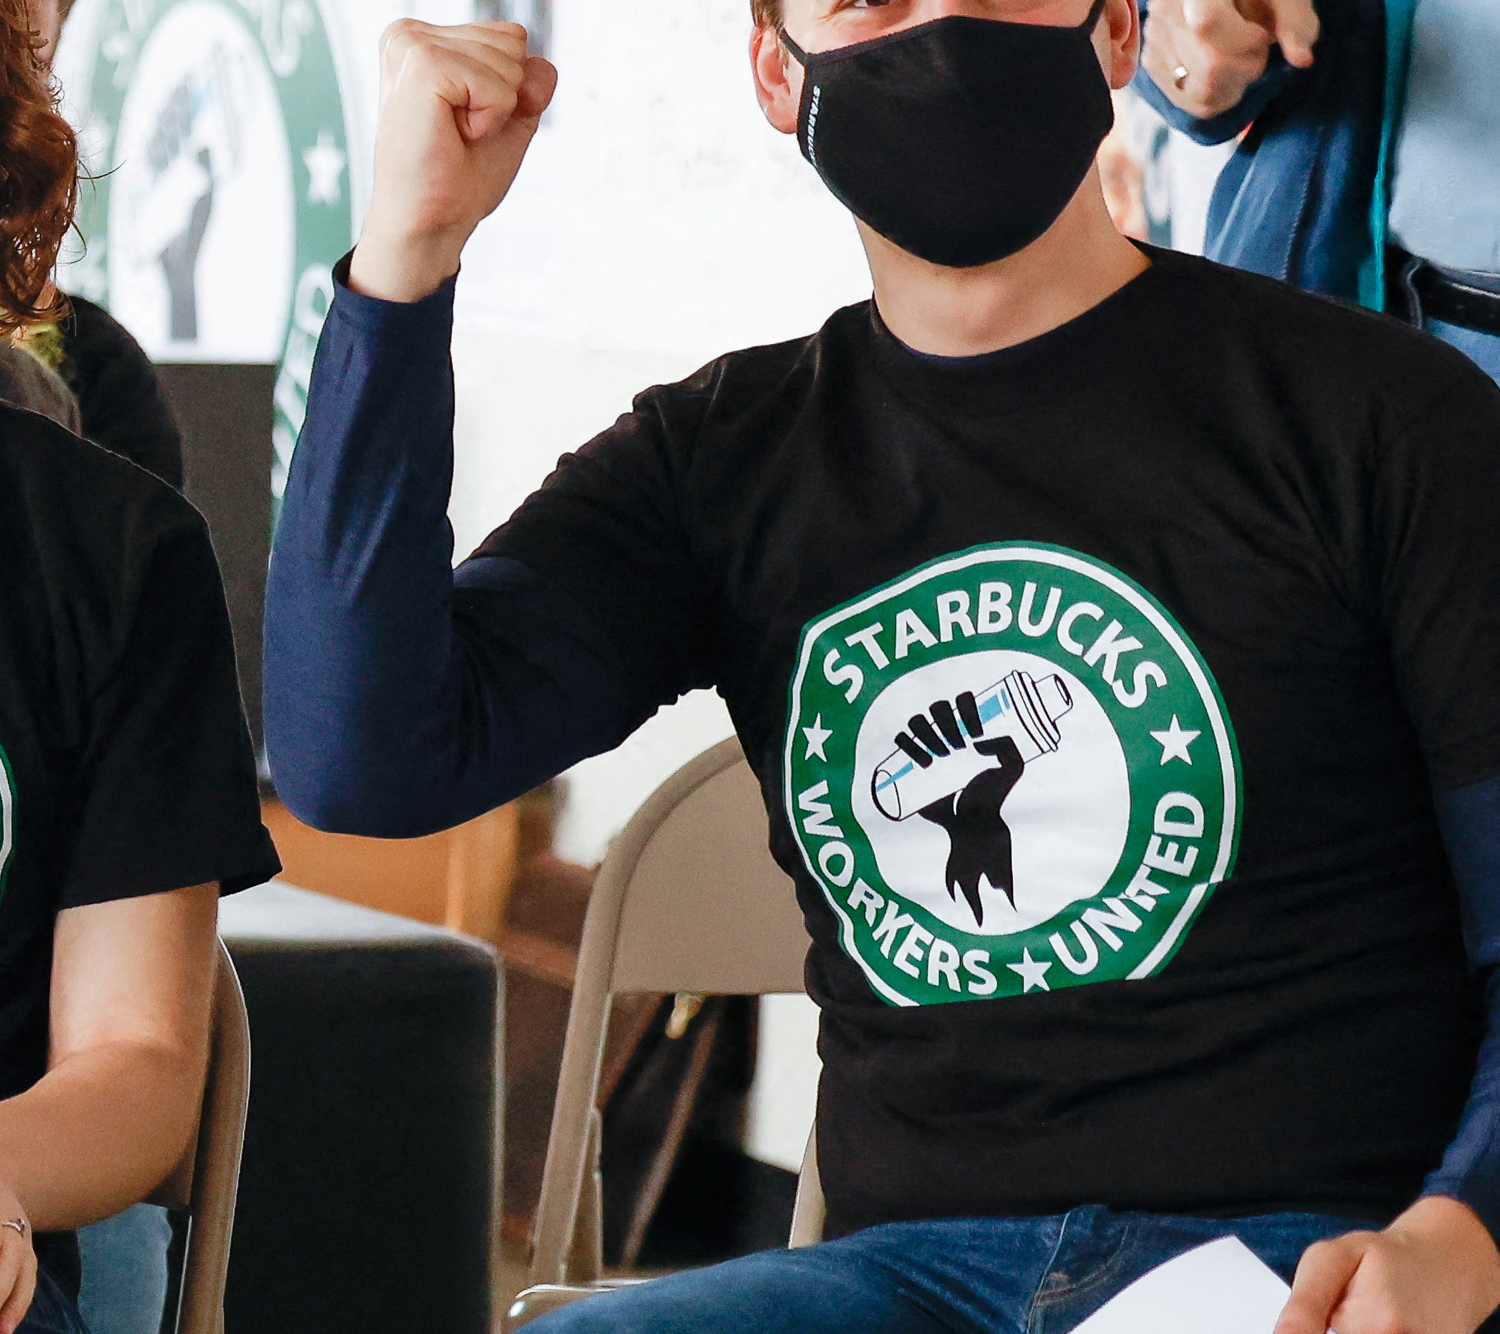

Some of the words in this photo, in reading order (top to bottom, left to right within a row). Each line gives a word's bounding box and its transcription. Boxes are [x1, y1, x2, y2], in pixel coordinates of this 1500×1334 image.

[822, 581, 1169, 710] STARBUCKS
[797, 780, 999, 996] WORKERS
[1049, 790, 1205, 977] UNITED
